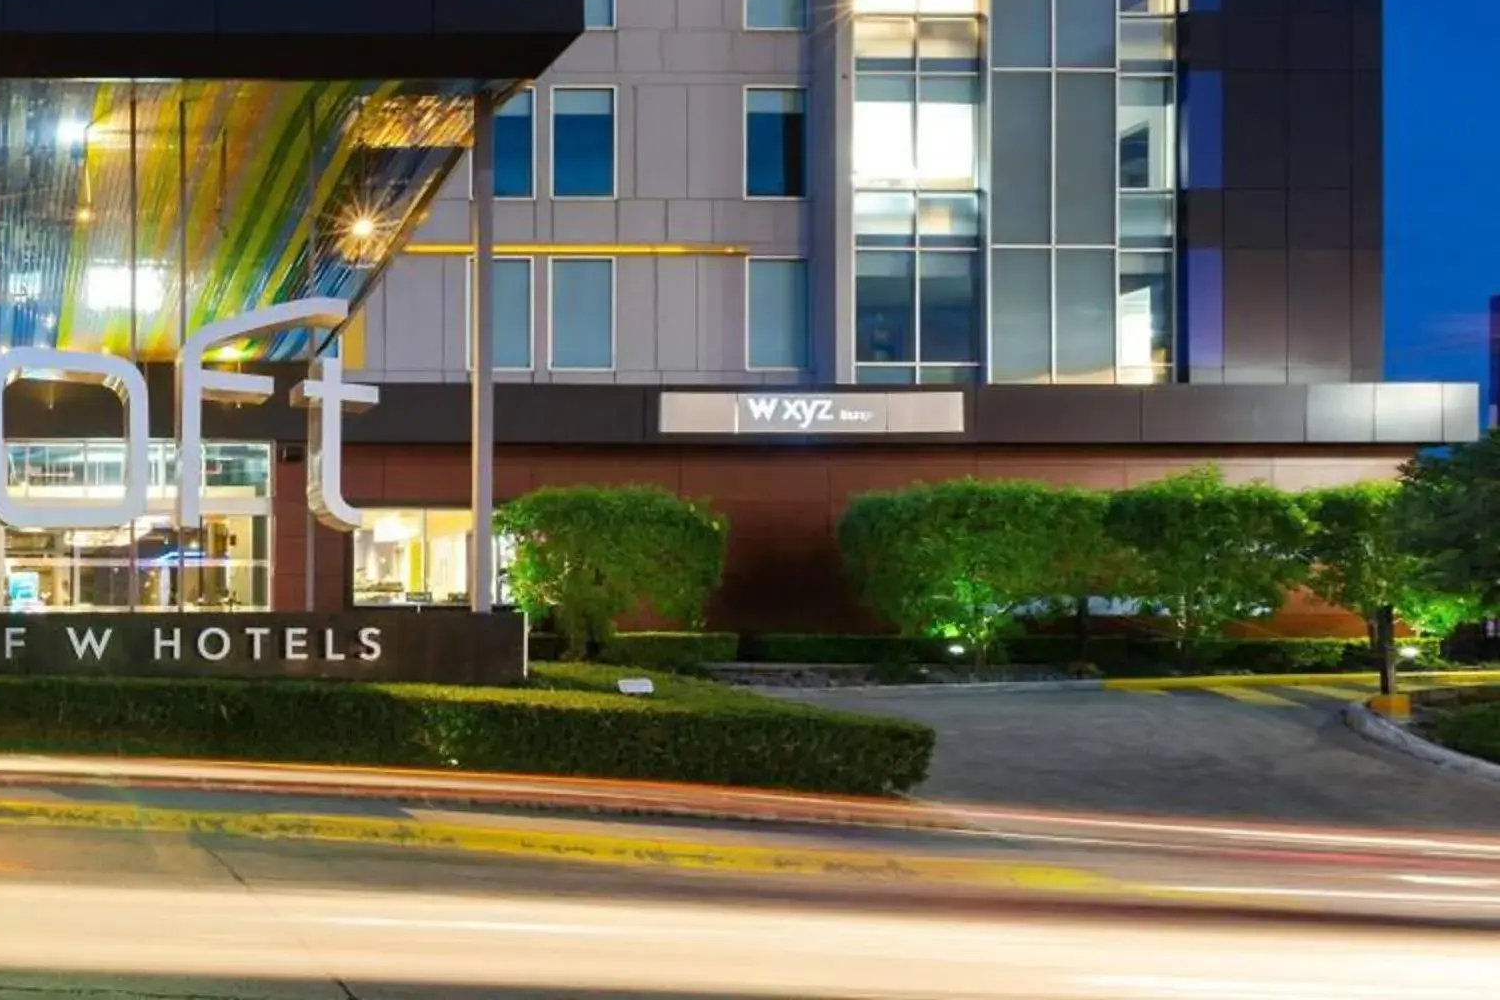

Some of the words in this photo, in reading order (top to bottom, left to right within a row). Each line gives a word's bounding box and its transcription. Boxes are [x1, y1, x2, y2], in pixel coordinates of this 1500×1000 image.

[781, 399, 835, 429] xyz
[66, 627, 113, 661] W
[153, 626, 382, 661] HOTELS
